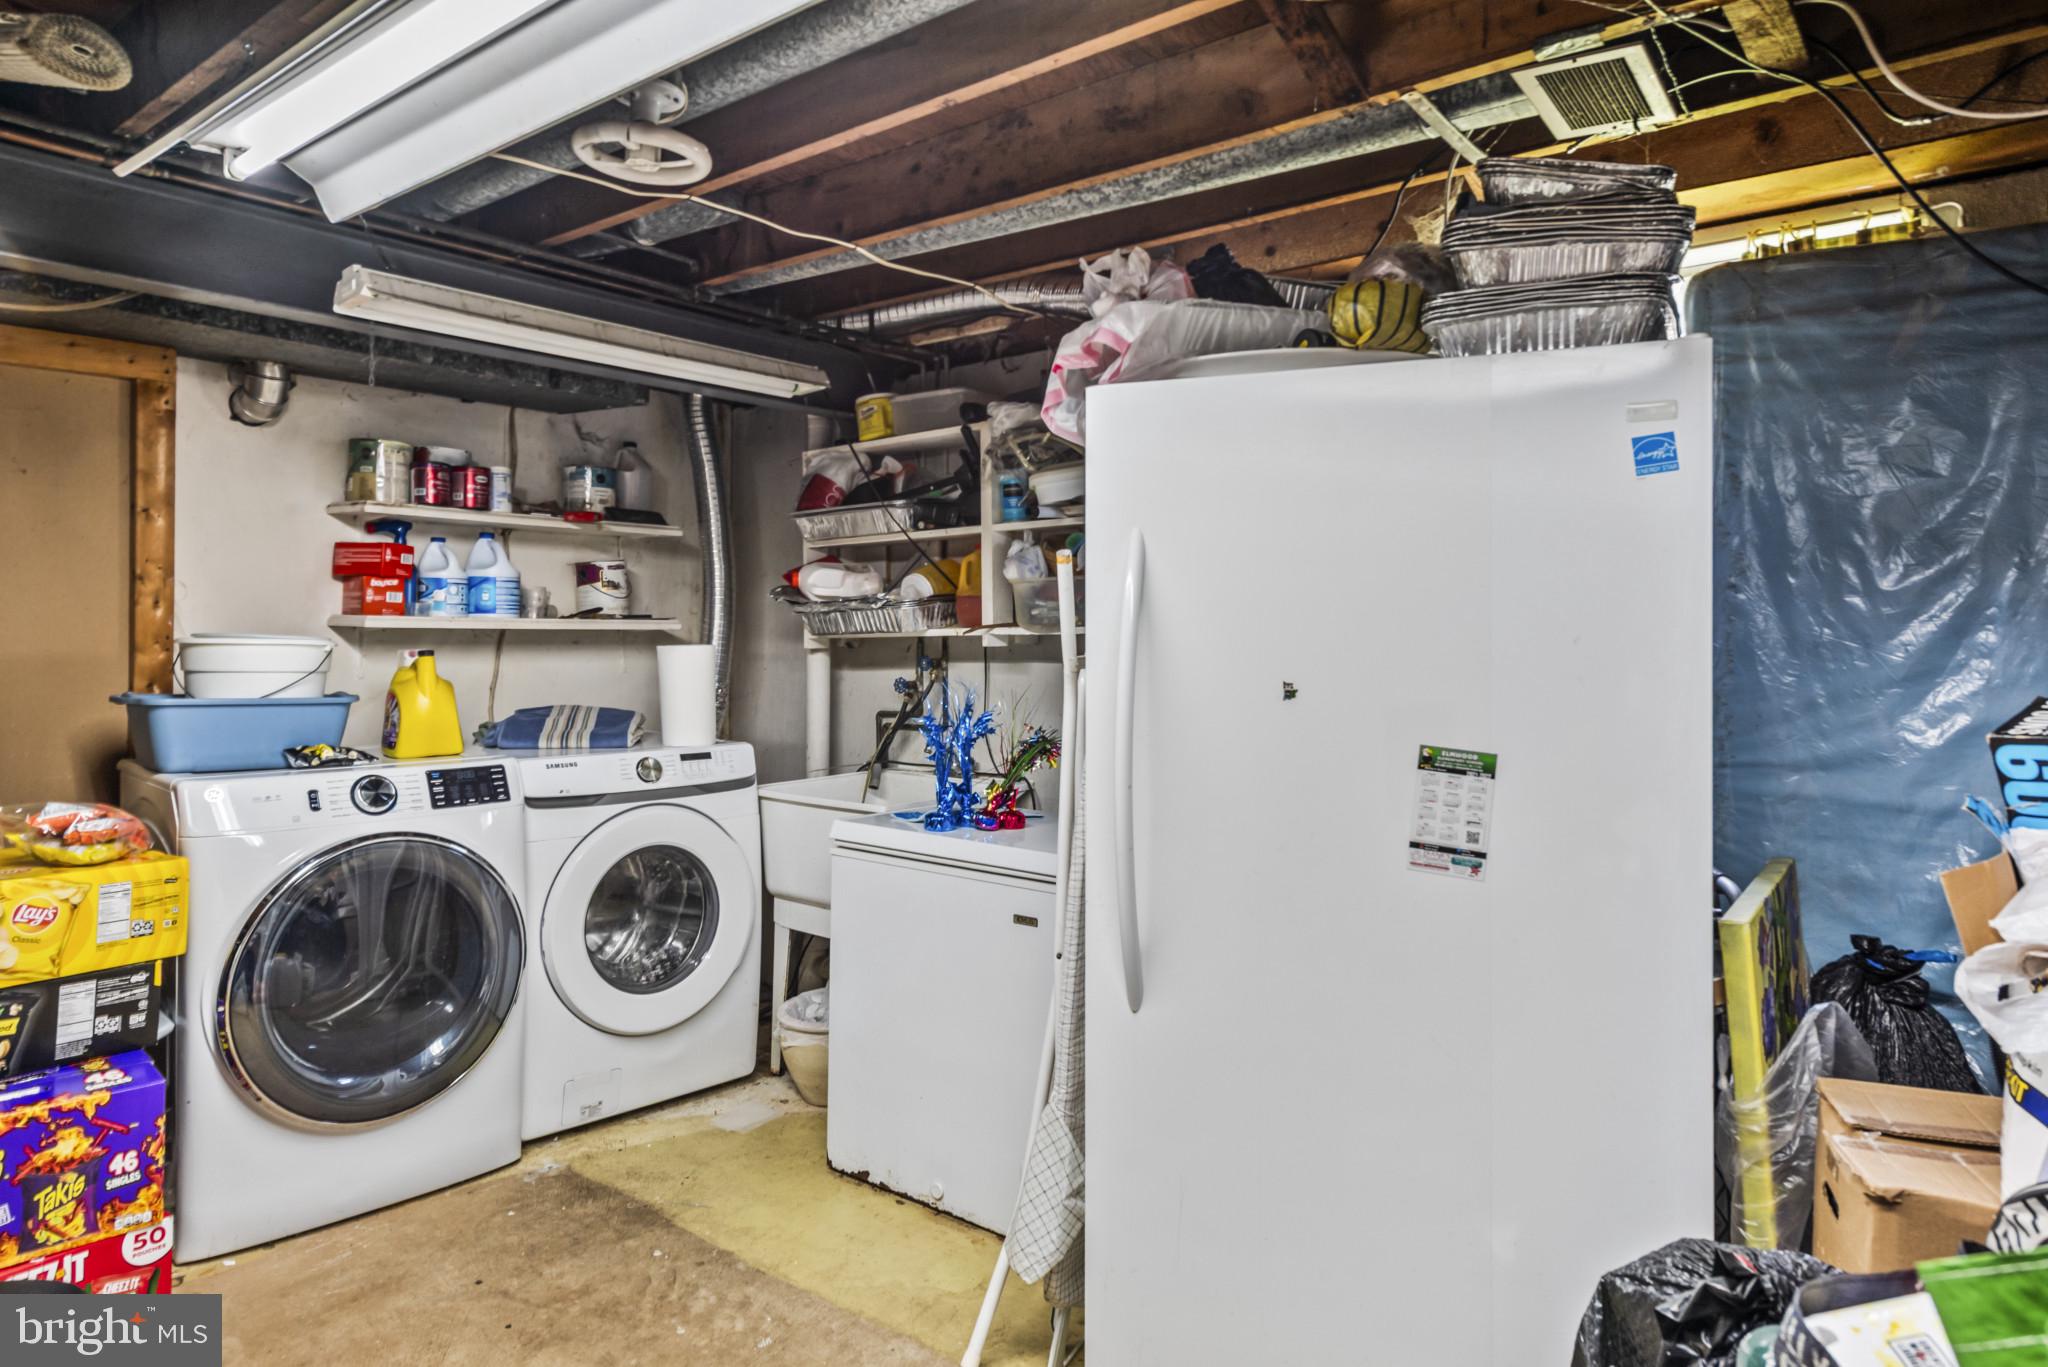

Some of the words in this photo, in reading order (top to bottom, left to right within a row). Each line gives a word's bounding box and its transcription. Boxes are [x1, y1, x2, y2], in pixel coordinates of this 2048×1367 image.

[545, 761, 578, 770] SAMSUNG
[12, 935, 41, 945] Classic
[109, 1150, 140, 1175] 46
[105, 1170, 142, 1190] SINGLES
[33, 1174, 86, 1220] Takis
[133, 1226, 166, 1251] 50
